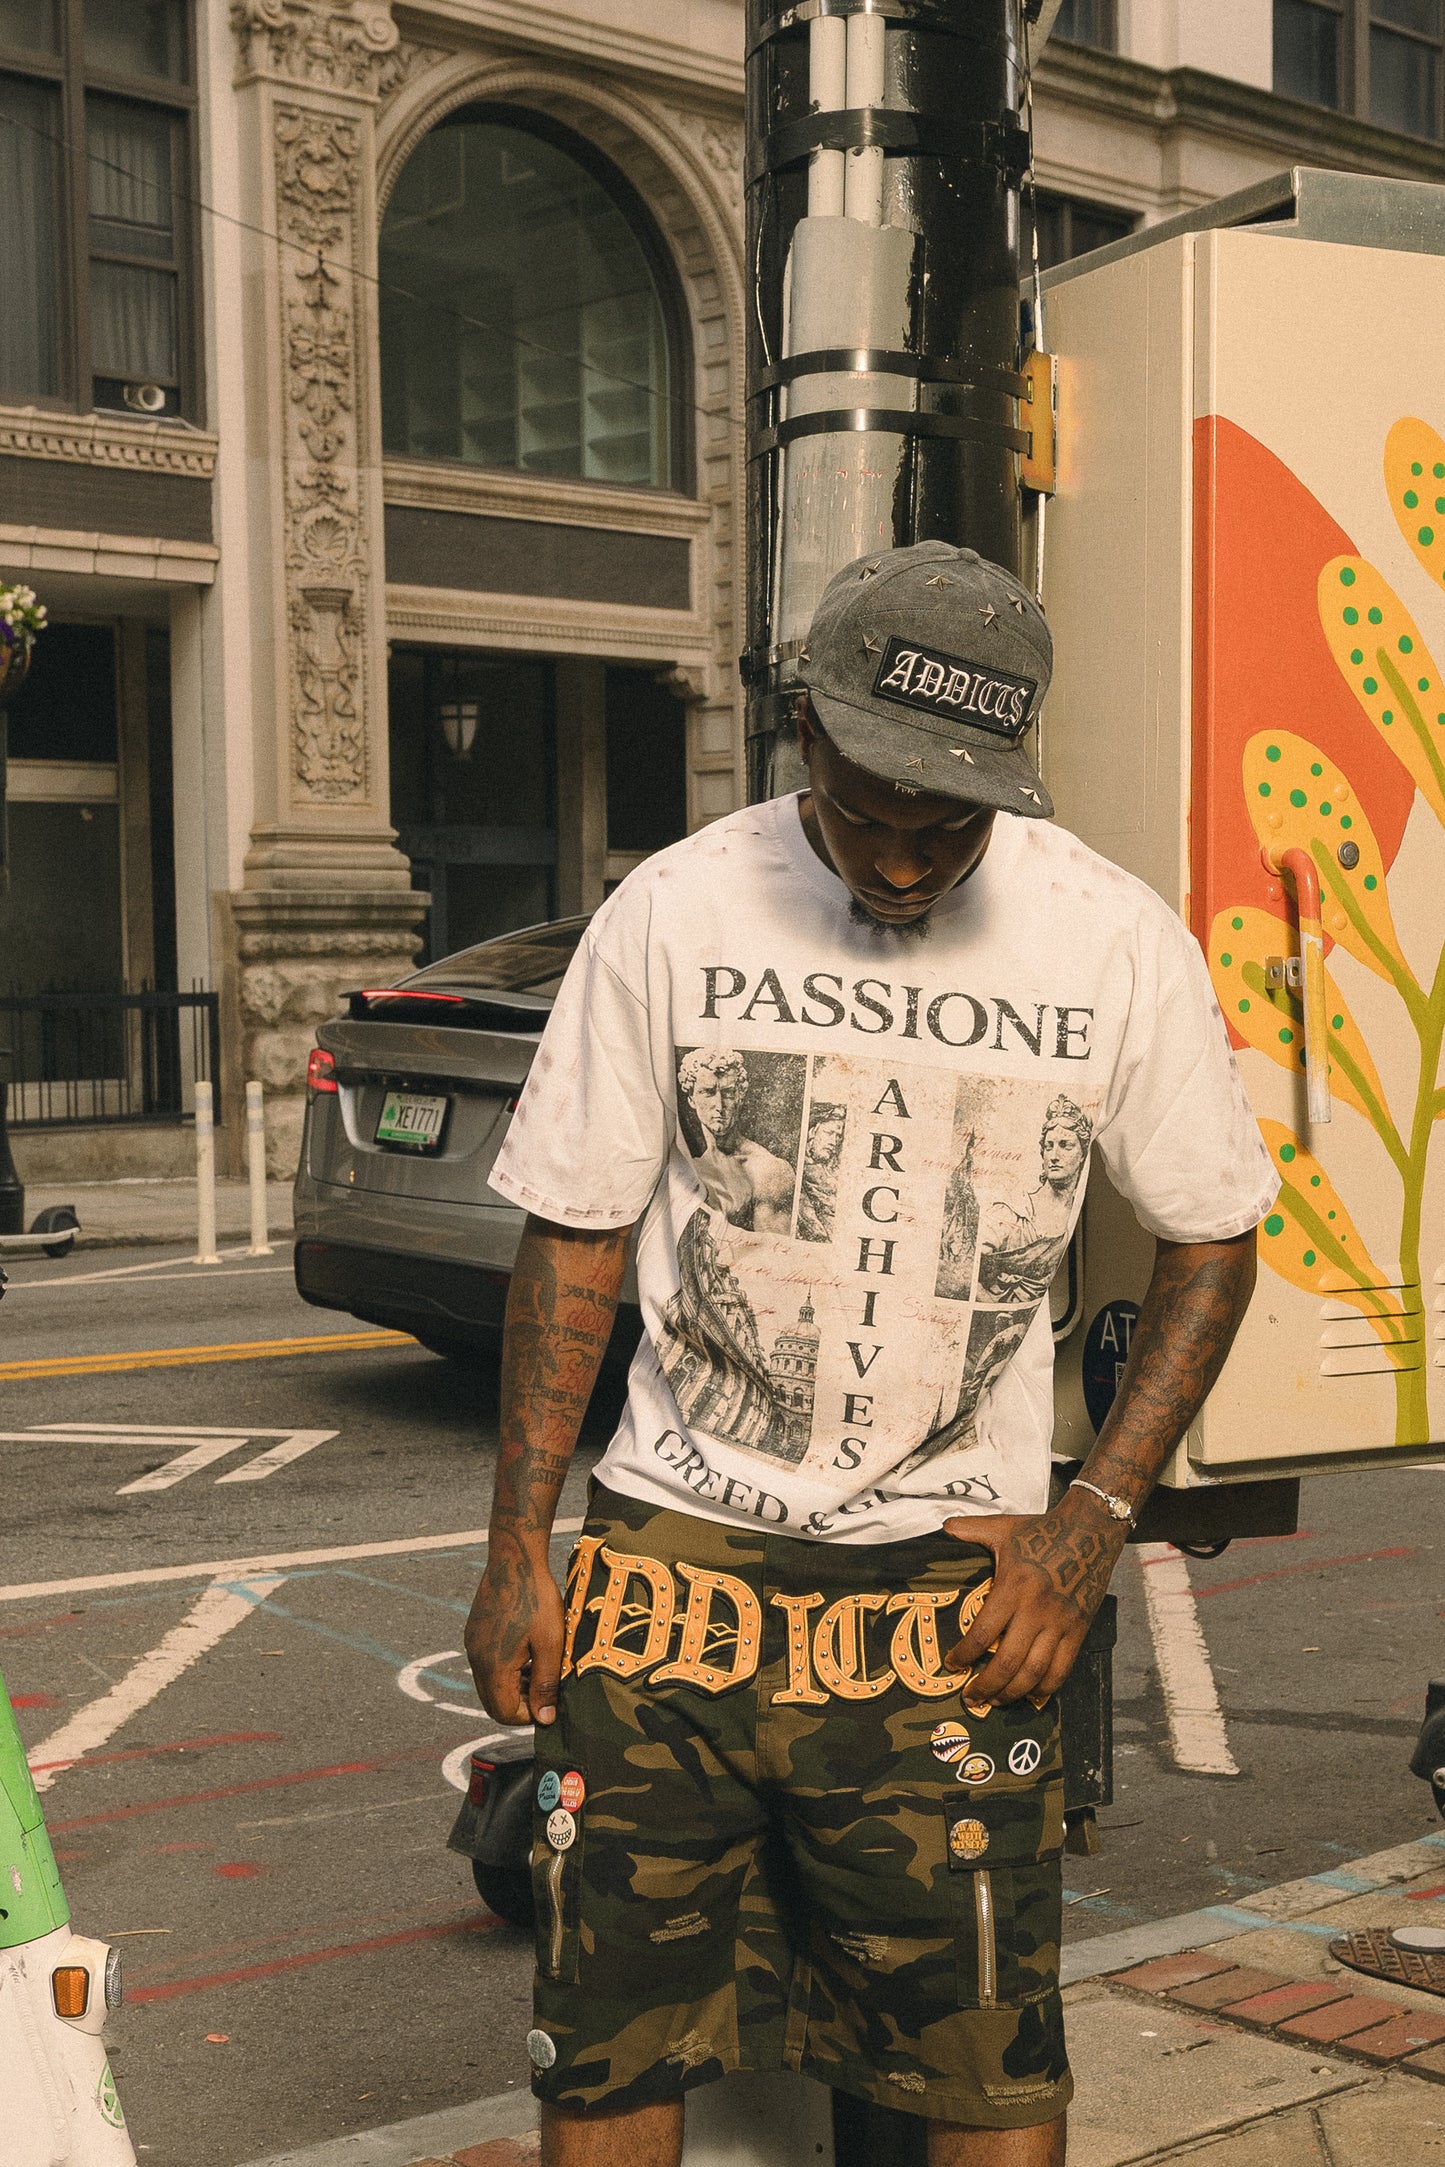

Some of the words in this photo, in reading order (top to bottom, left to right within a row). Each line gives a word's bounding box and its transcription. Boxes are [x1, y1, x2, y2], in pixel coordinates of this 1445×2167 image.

[880, 650, 1030, 726] ADDICTS
[698, 966, 1095, 1060] PASSIONE
[832, 1078, 913, 1470] ARCHIVES
[653, 1429, 789, 1523] GREED
[837, 1474, 1002, 1515] GRY
